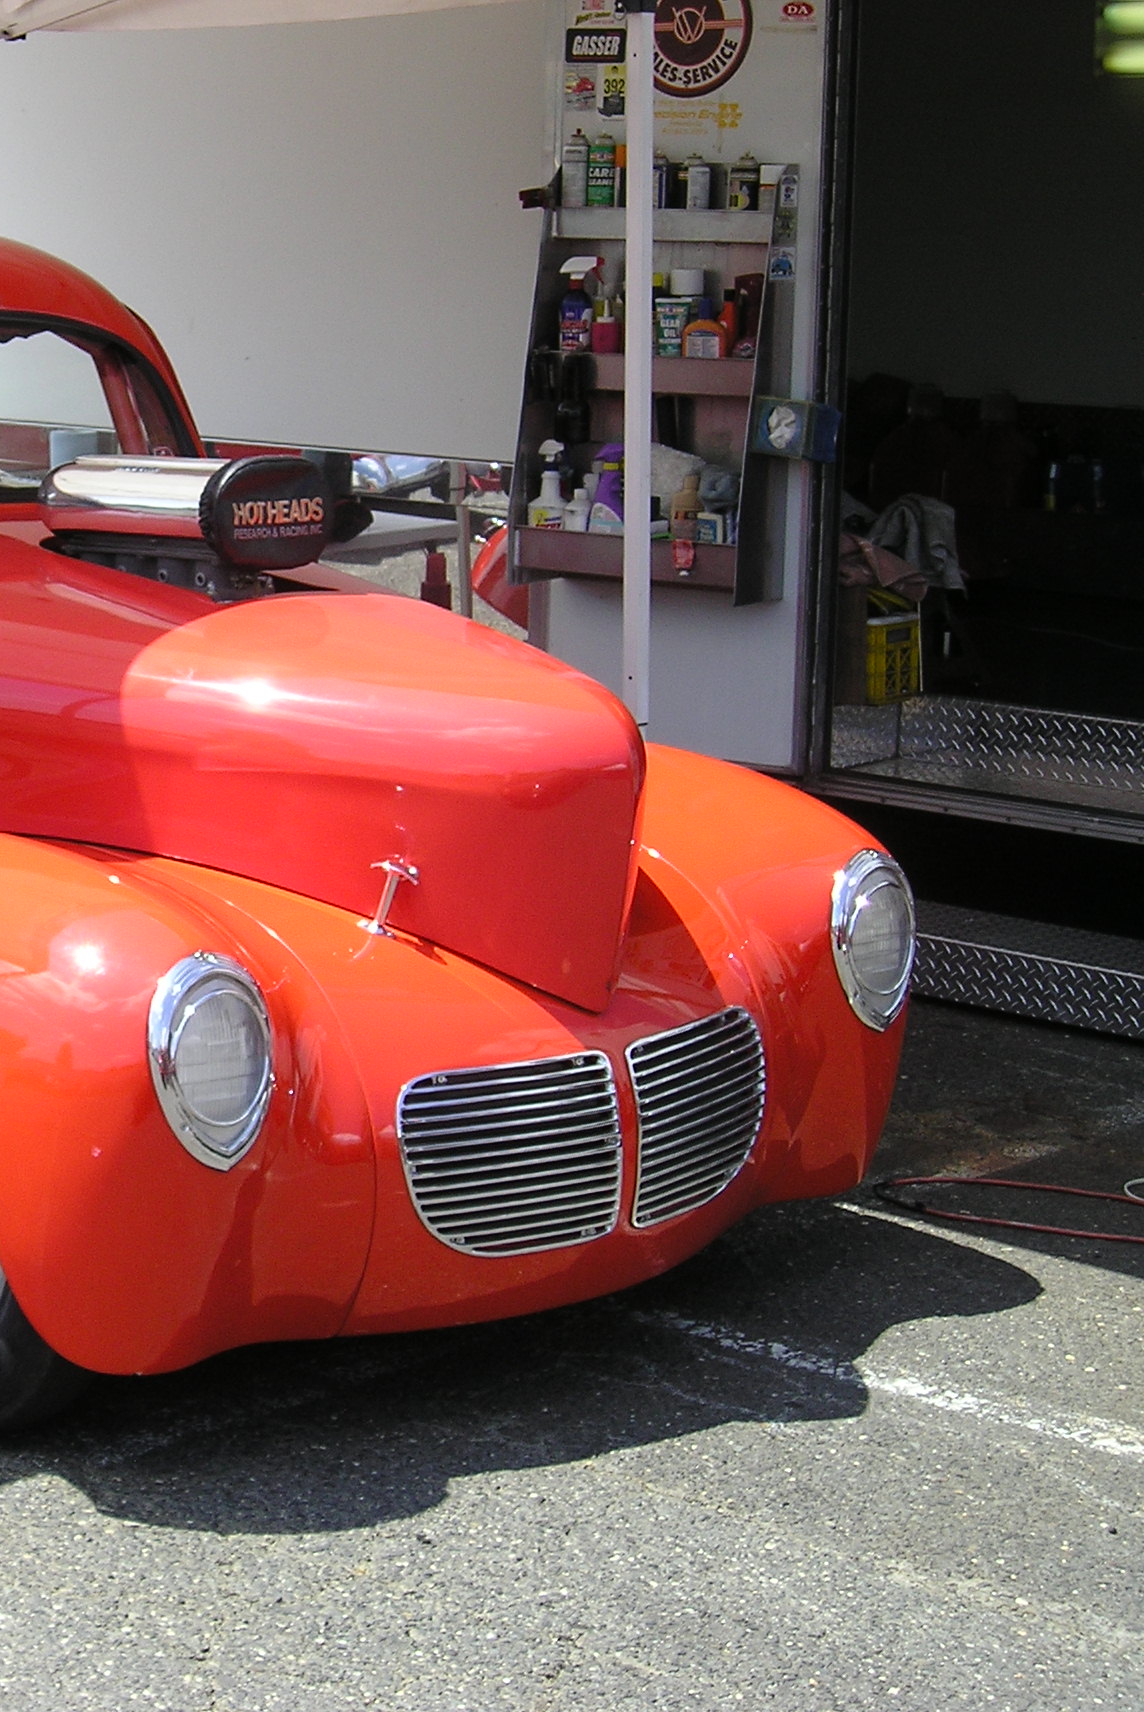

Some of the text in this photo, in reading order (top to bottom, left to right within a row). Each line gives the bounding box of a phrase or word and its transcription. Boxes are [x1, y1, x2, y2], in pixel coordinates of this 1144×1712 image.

[572, 35, 621, 56] GASSER
[653, 38, 738, 86] LES-SERVICE
[603, 79, 626, 94] 392
[232, 497, 324, 525] HOT HEADS
[234, 527, 271, 540] RESEARCH
